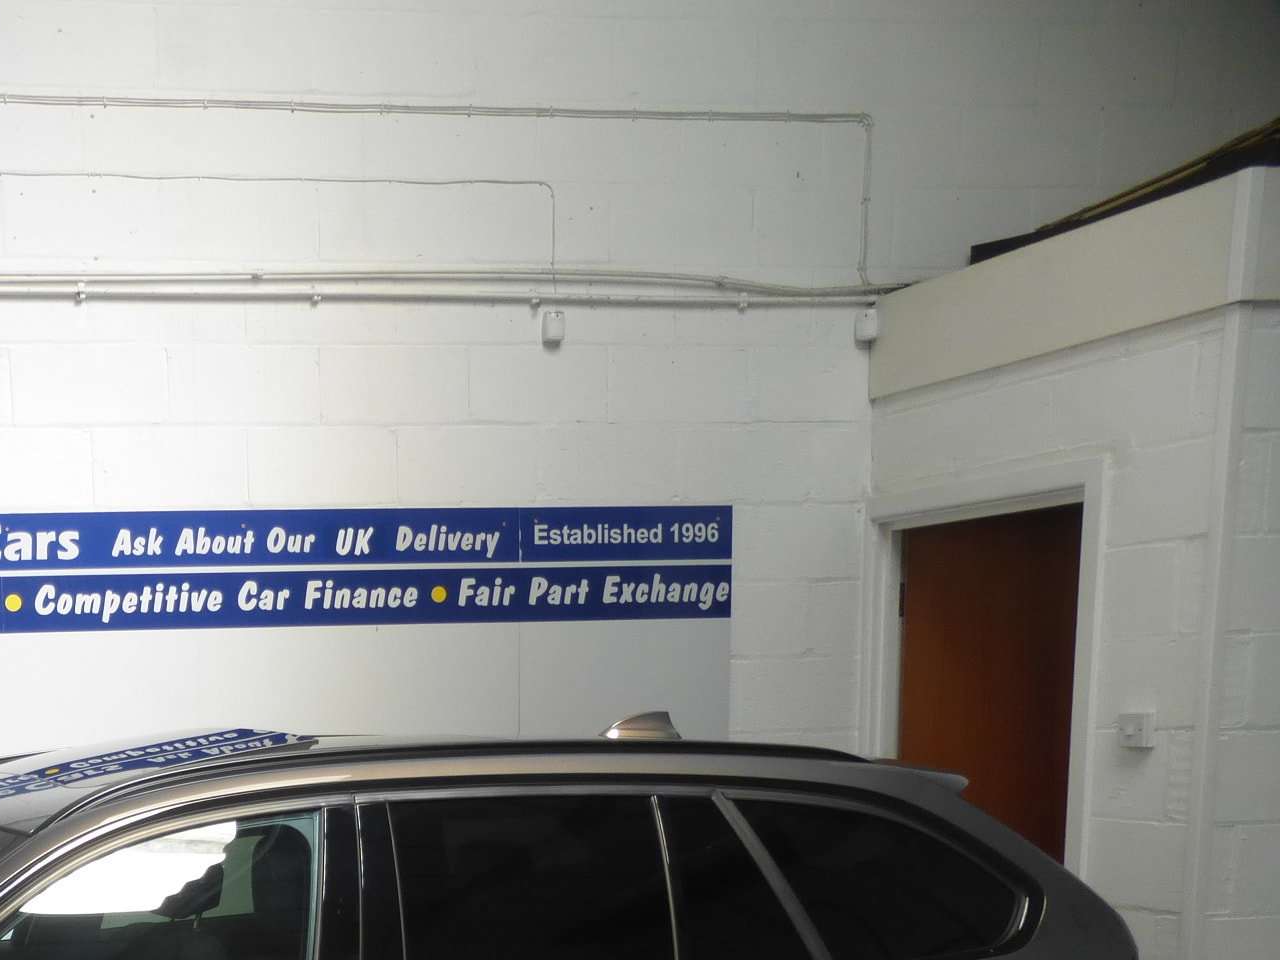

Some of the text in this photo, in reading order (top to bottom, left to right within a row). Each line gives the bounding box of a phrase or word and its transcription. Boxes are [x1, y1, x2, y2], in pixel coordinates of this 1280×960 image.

[111, 525, 500, 559] Ask About Our UK Delivery
[533, 522, 719, 545] Established 1996
[34, 579, 418, 624] Competitive Car Finance
[457, 573, 730, 611] Fair Part Exchange
